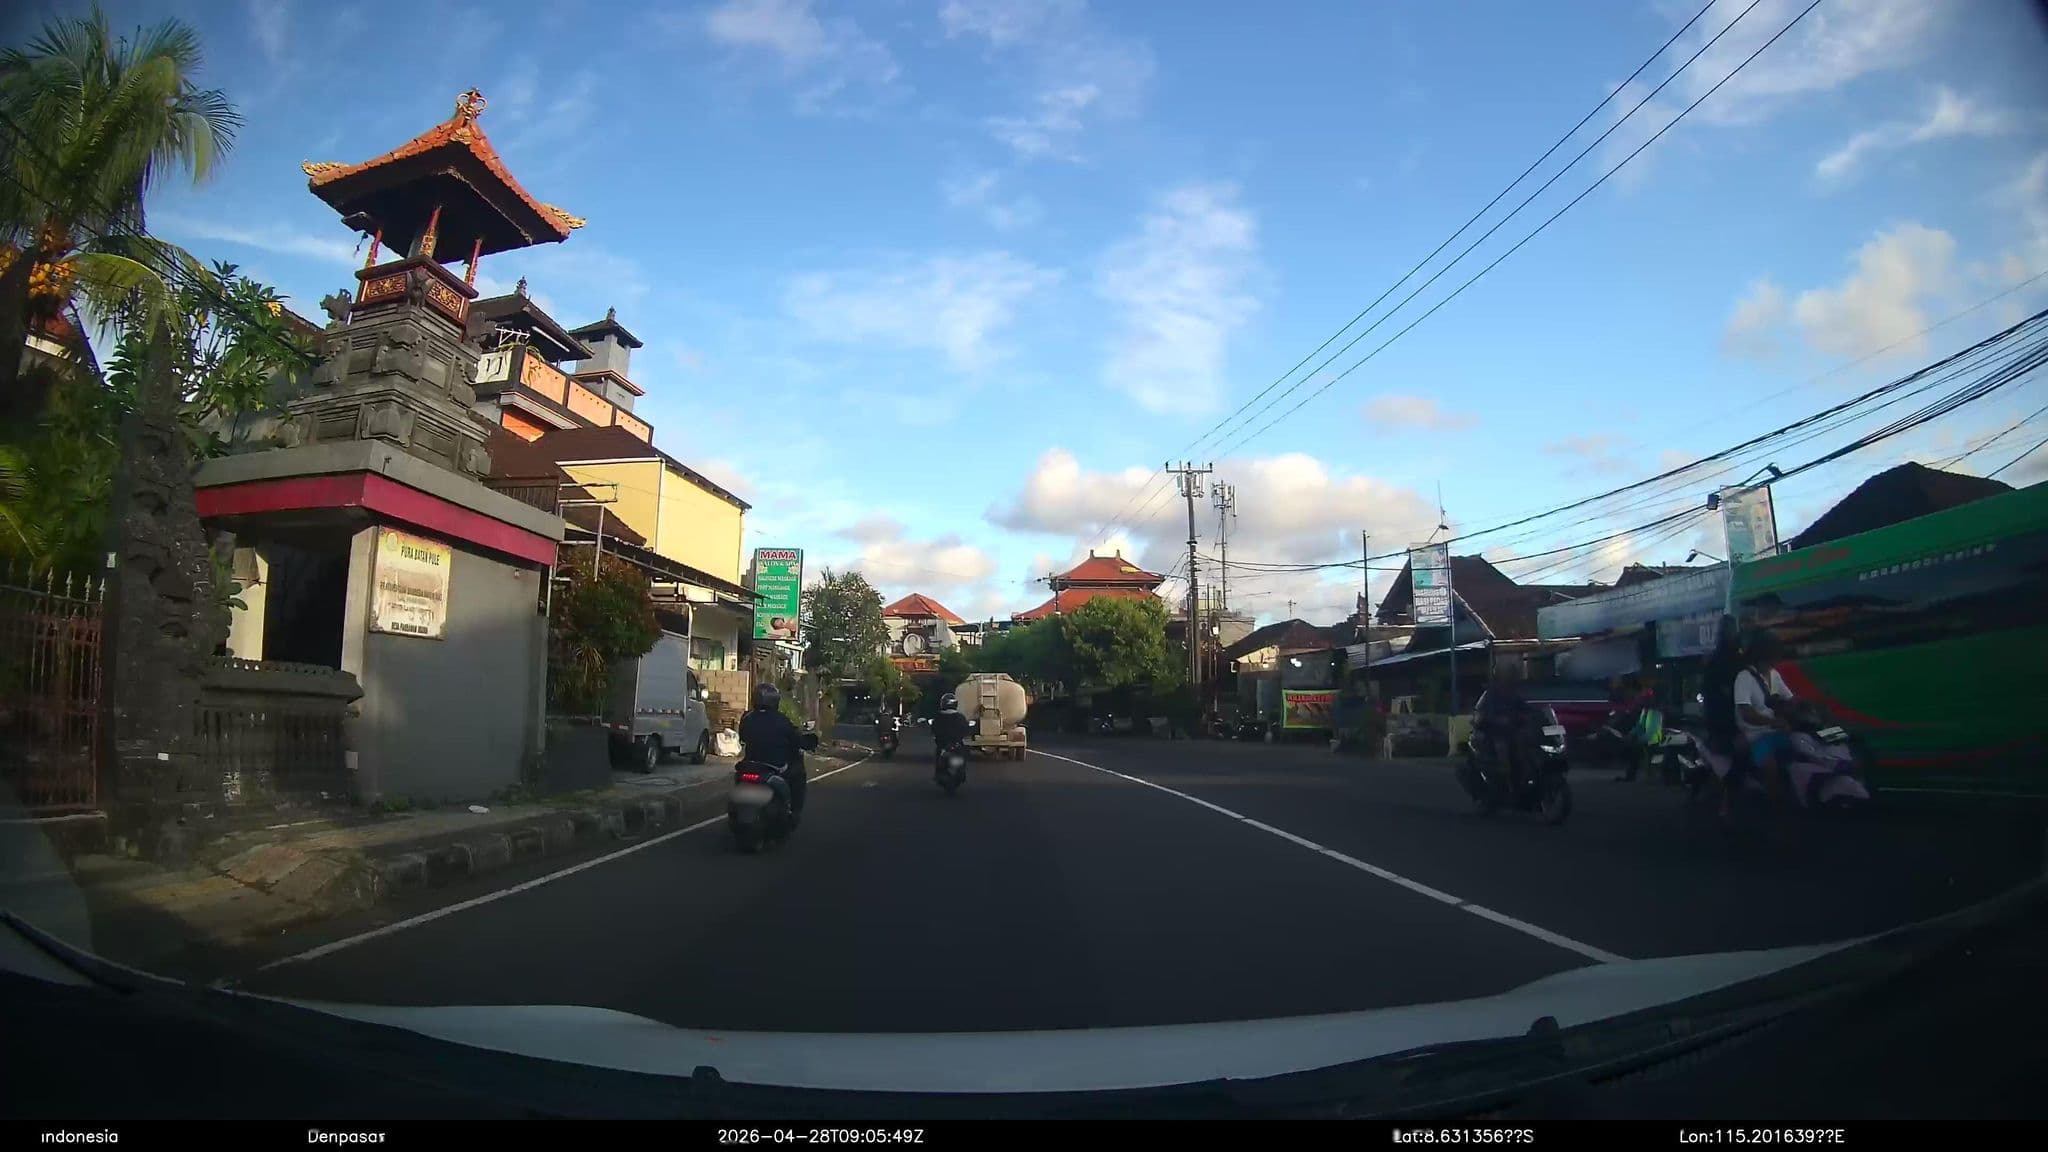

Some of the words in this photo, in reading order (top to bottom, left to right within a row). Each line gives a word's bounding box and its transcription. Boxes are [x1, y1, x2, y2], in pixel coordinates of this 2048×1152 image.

[401, 546, 414, 559] PURA
[429, 551, 440, 566] PULE
[759, 550, 797, 560] MAMA
